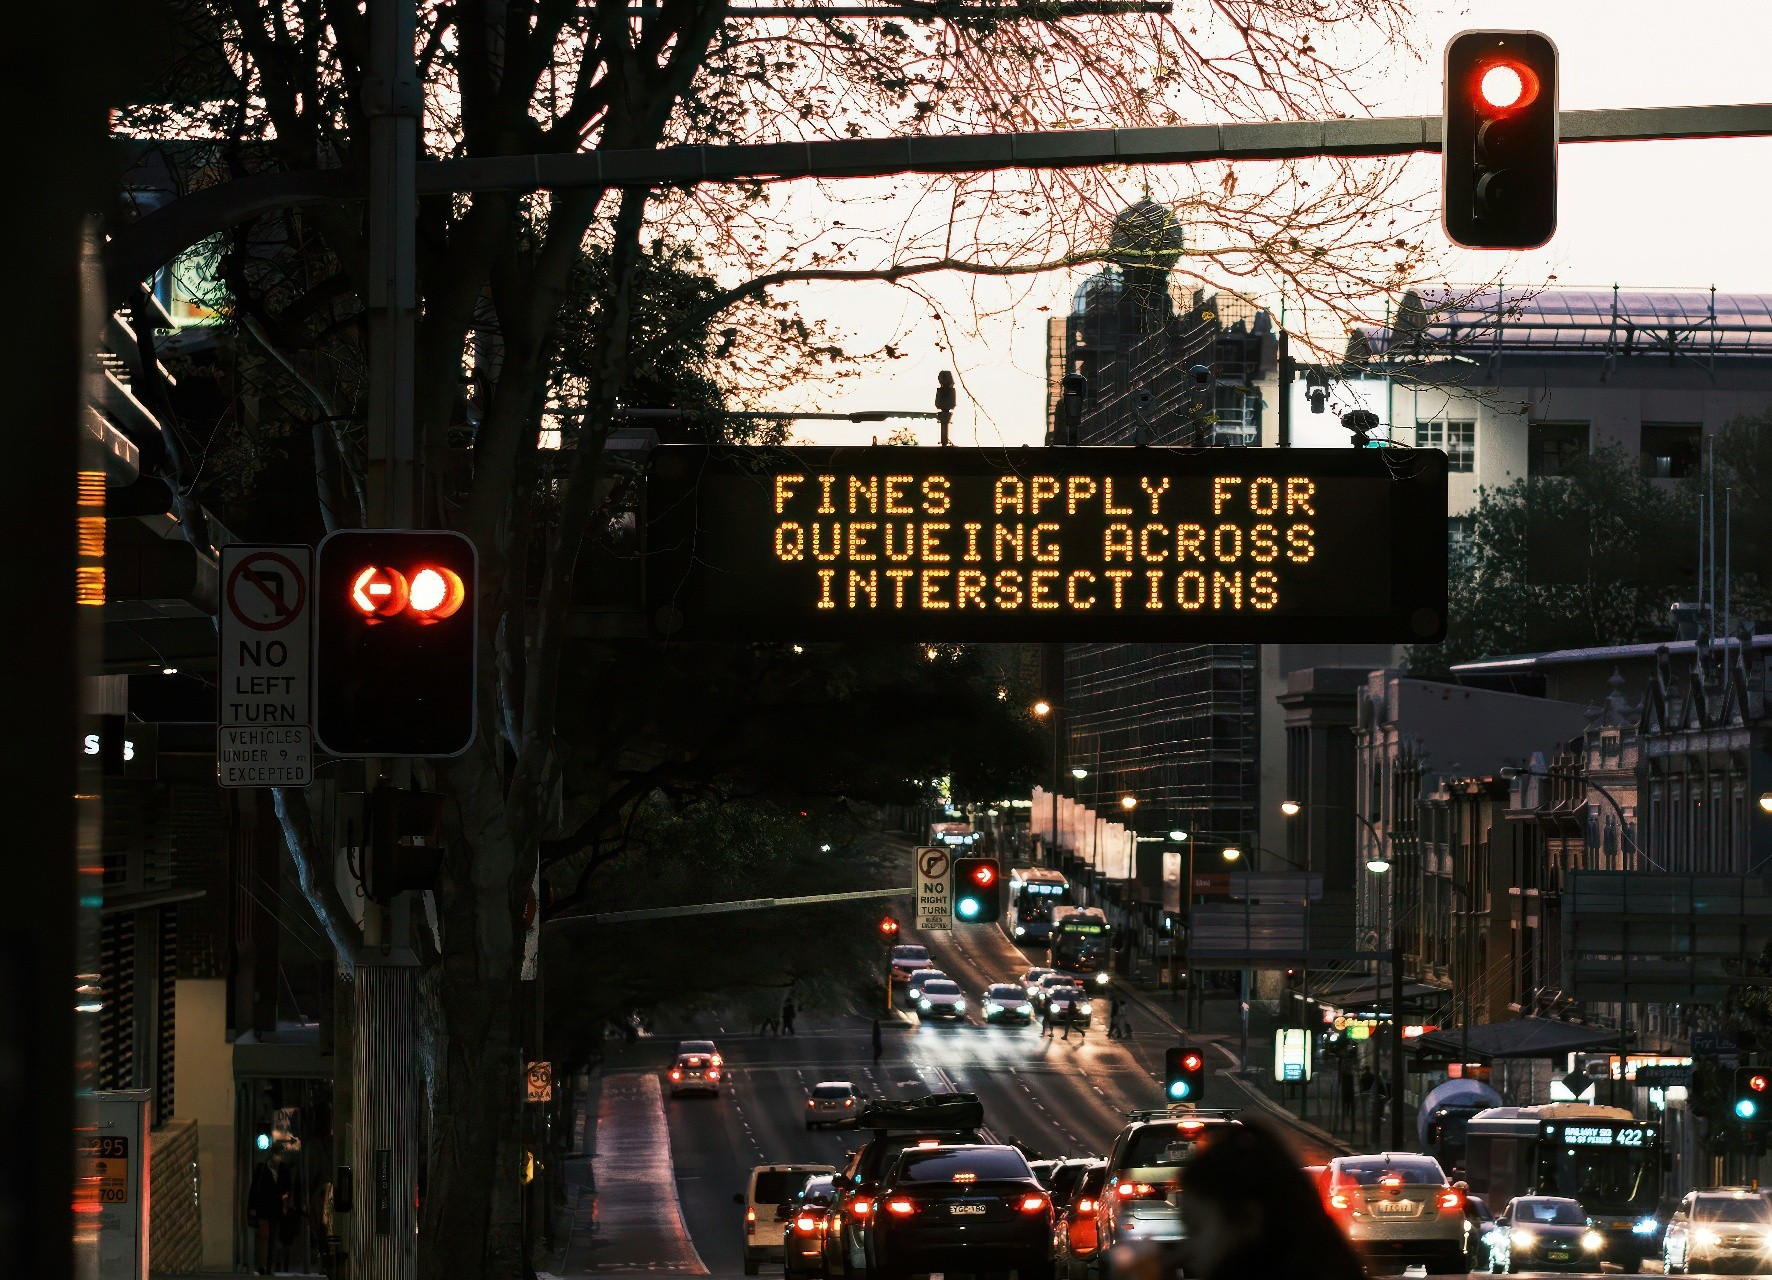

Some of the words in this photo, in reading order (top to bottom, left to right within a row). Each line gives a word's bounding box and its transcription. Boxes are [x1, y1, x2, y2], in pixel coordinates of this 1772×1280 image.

[775, 474, 950, 514] FINES
[995, 475, 1170, 515] APPLY
[1213, 476, 1316, 516] FOR
[775, 522, 1060, 562] QUEUEING
[1103, 522, 1316, 563] ACROSS
[817, 569, 1279, 610] INTERSECTIONS
[239, 640, 288, 667] NO
[236, 676, 295, 694] LEFT
[230, 703, 295, 721] TURN
[229, 730, 302, 745] VEHICLES
[223, 749, 268, 762] UNDER
[279, 749, 288, 761] 9
[229, 767, 304, 781] EXCEPTED
[924, 882, 944, 893] NO
[921, 906, 947, 914] TURN
[1616, 1129, 1642, 1145] 422
